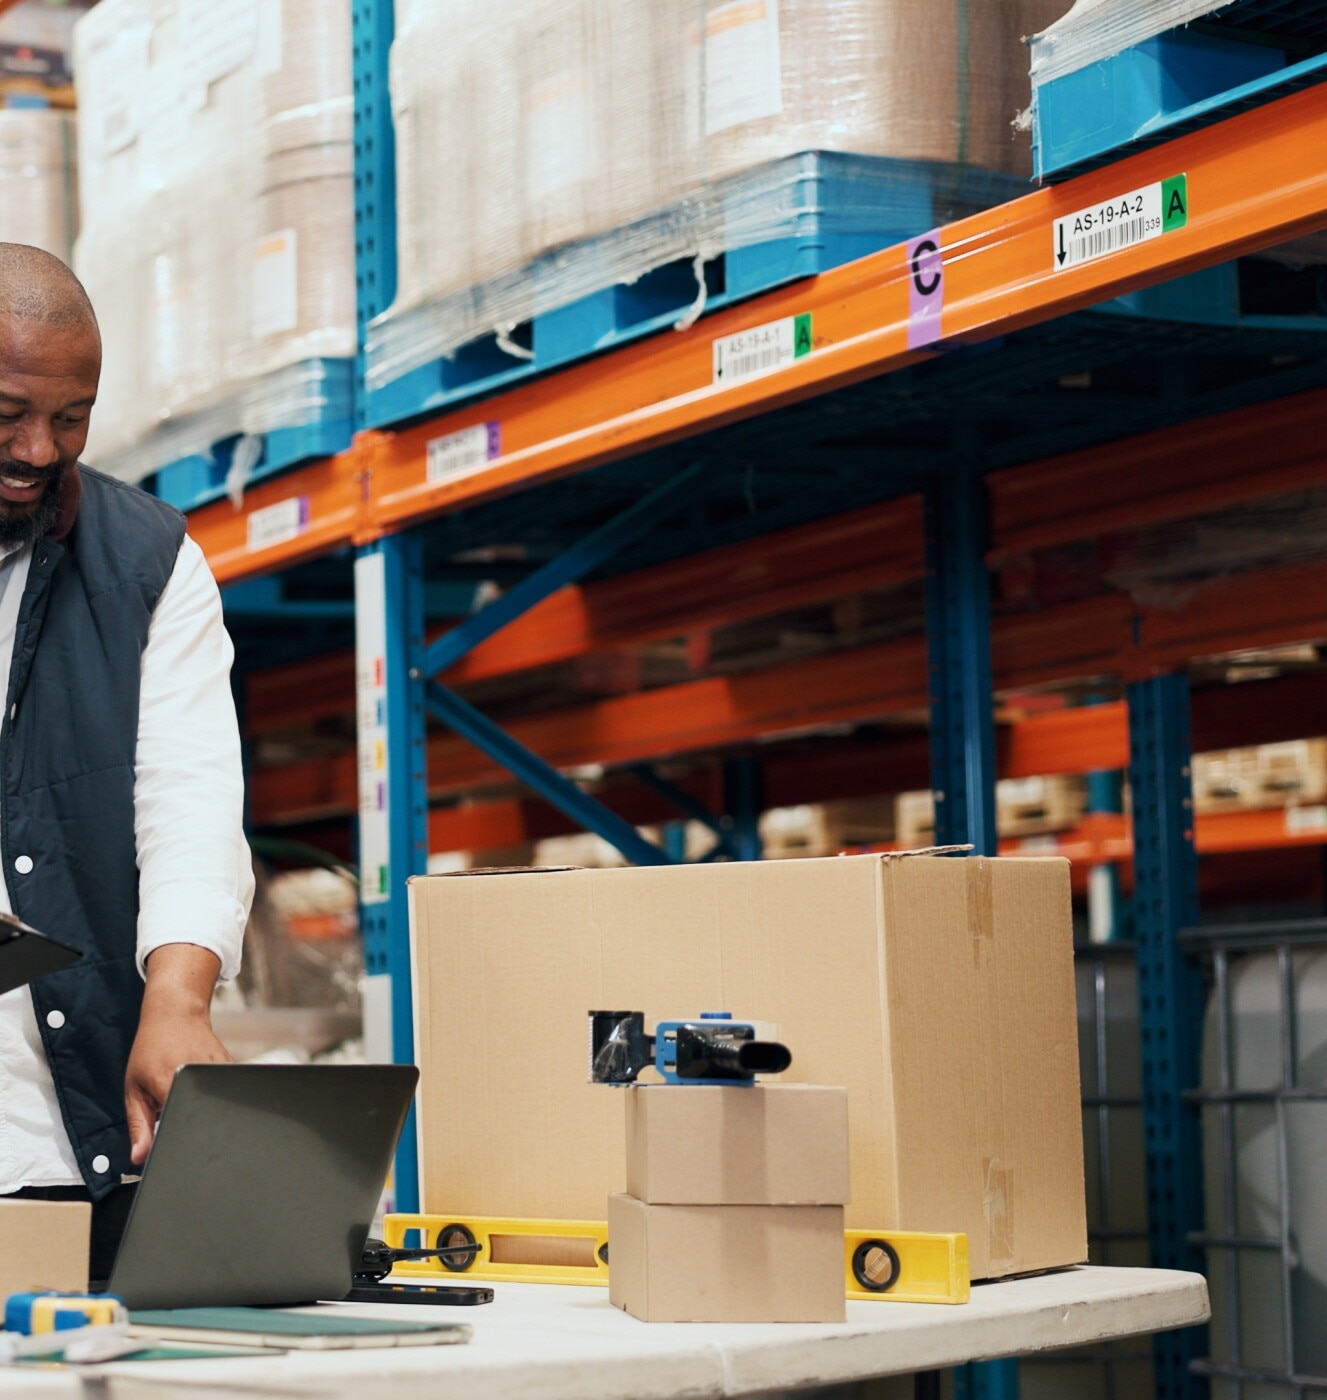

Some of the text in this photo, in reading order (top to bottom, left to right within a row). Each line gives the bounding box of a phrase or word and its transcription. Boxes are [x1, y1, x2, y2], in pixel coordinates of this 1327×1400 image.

[1072, 195, 1144, 235] AS-19-A-2
[1167, 189, 1185, 220] A
[1145, 217, 1161, 232] 339
[912, 240, 941, 296] C
[796, 325, 811, 350] A
